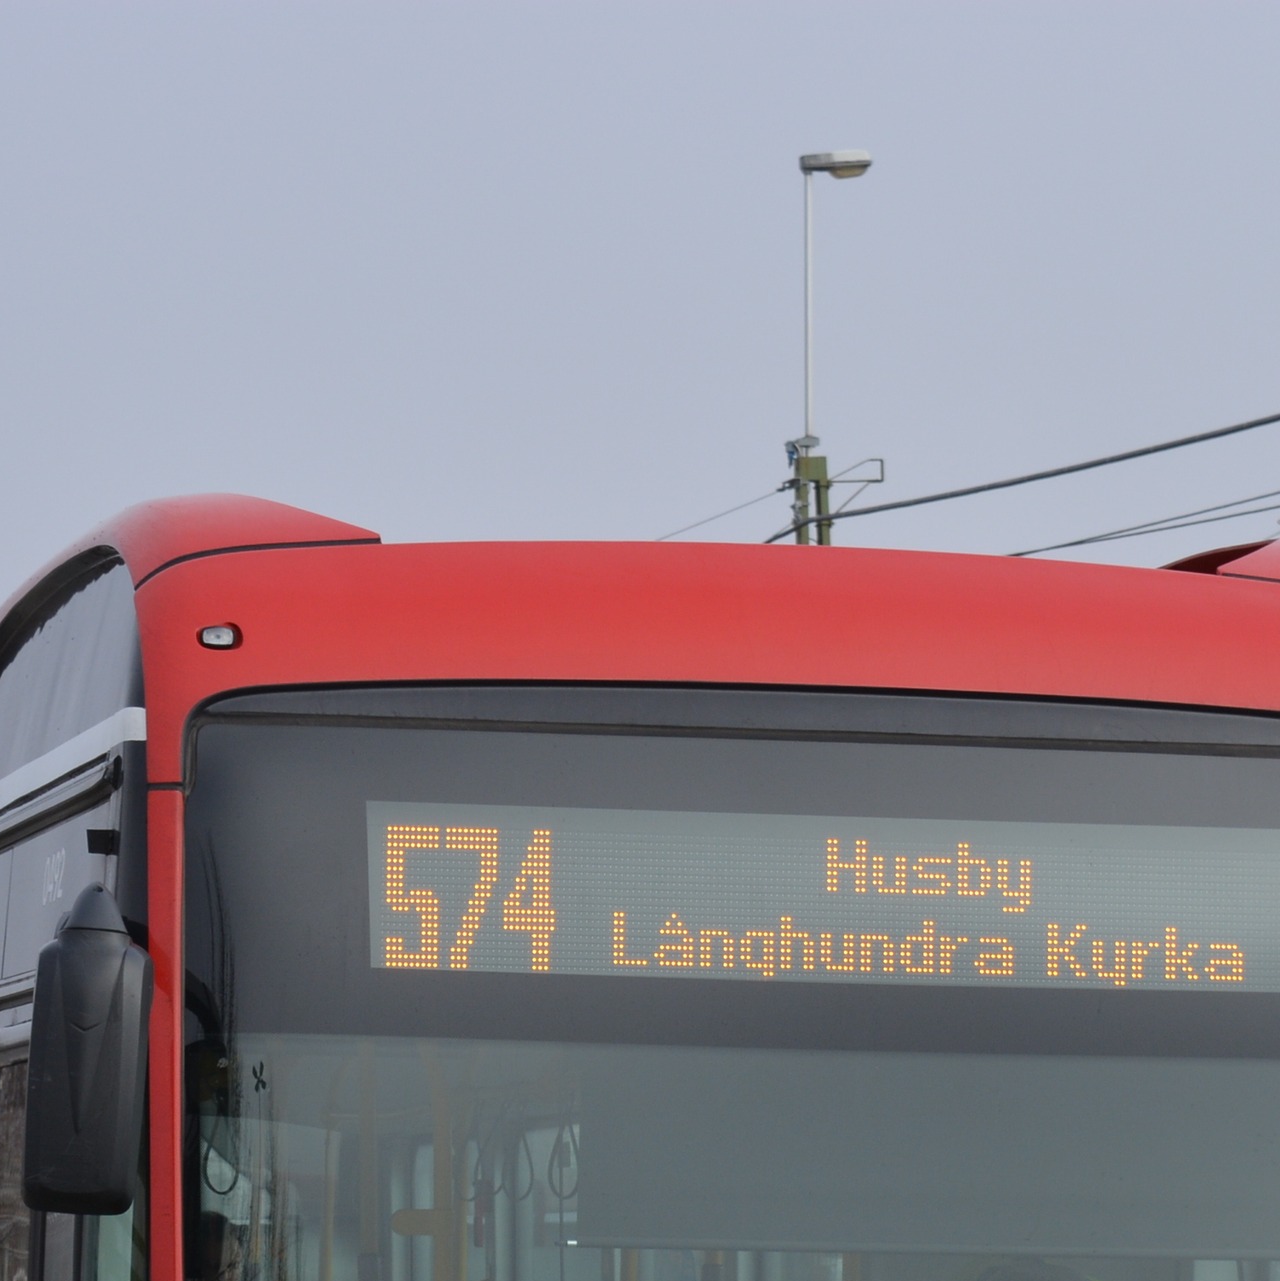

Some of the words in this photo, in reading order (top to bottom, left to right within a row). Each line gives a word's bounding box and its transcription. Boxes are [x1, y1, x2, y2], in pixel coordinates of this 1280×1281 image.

[385, 825, 555, 971] 574
[825, 838, 1033, 913] Husby
[612, 910, 1014, 977] Långhundra
[1046, 922, 1245, 986] Kyrka
